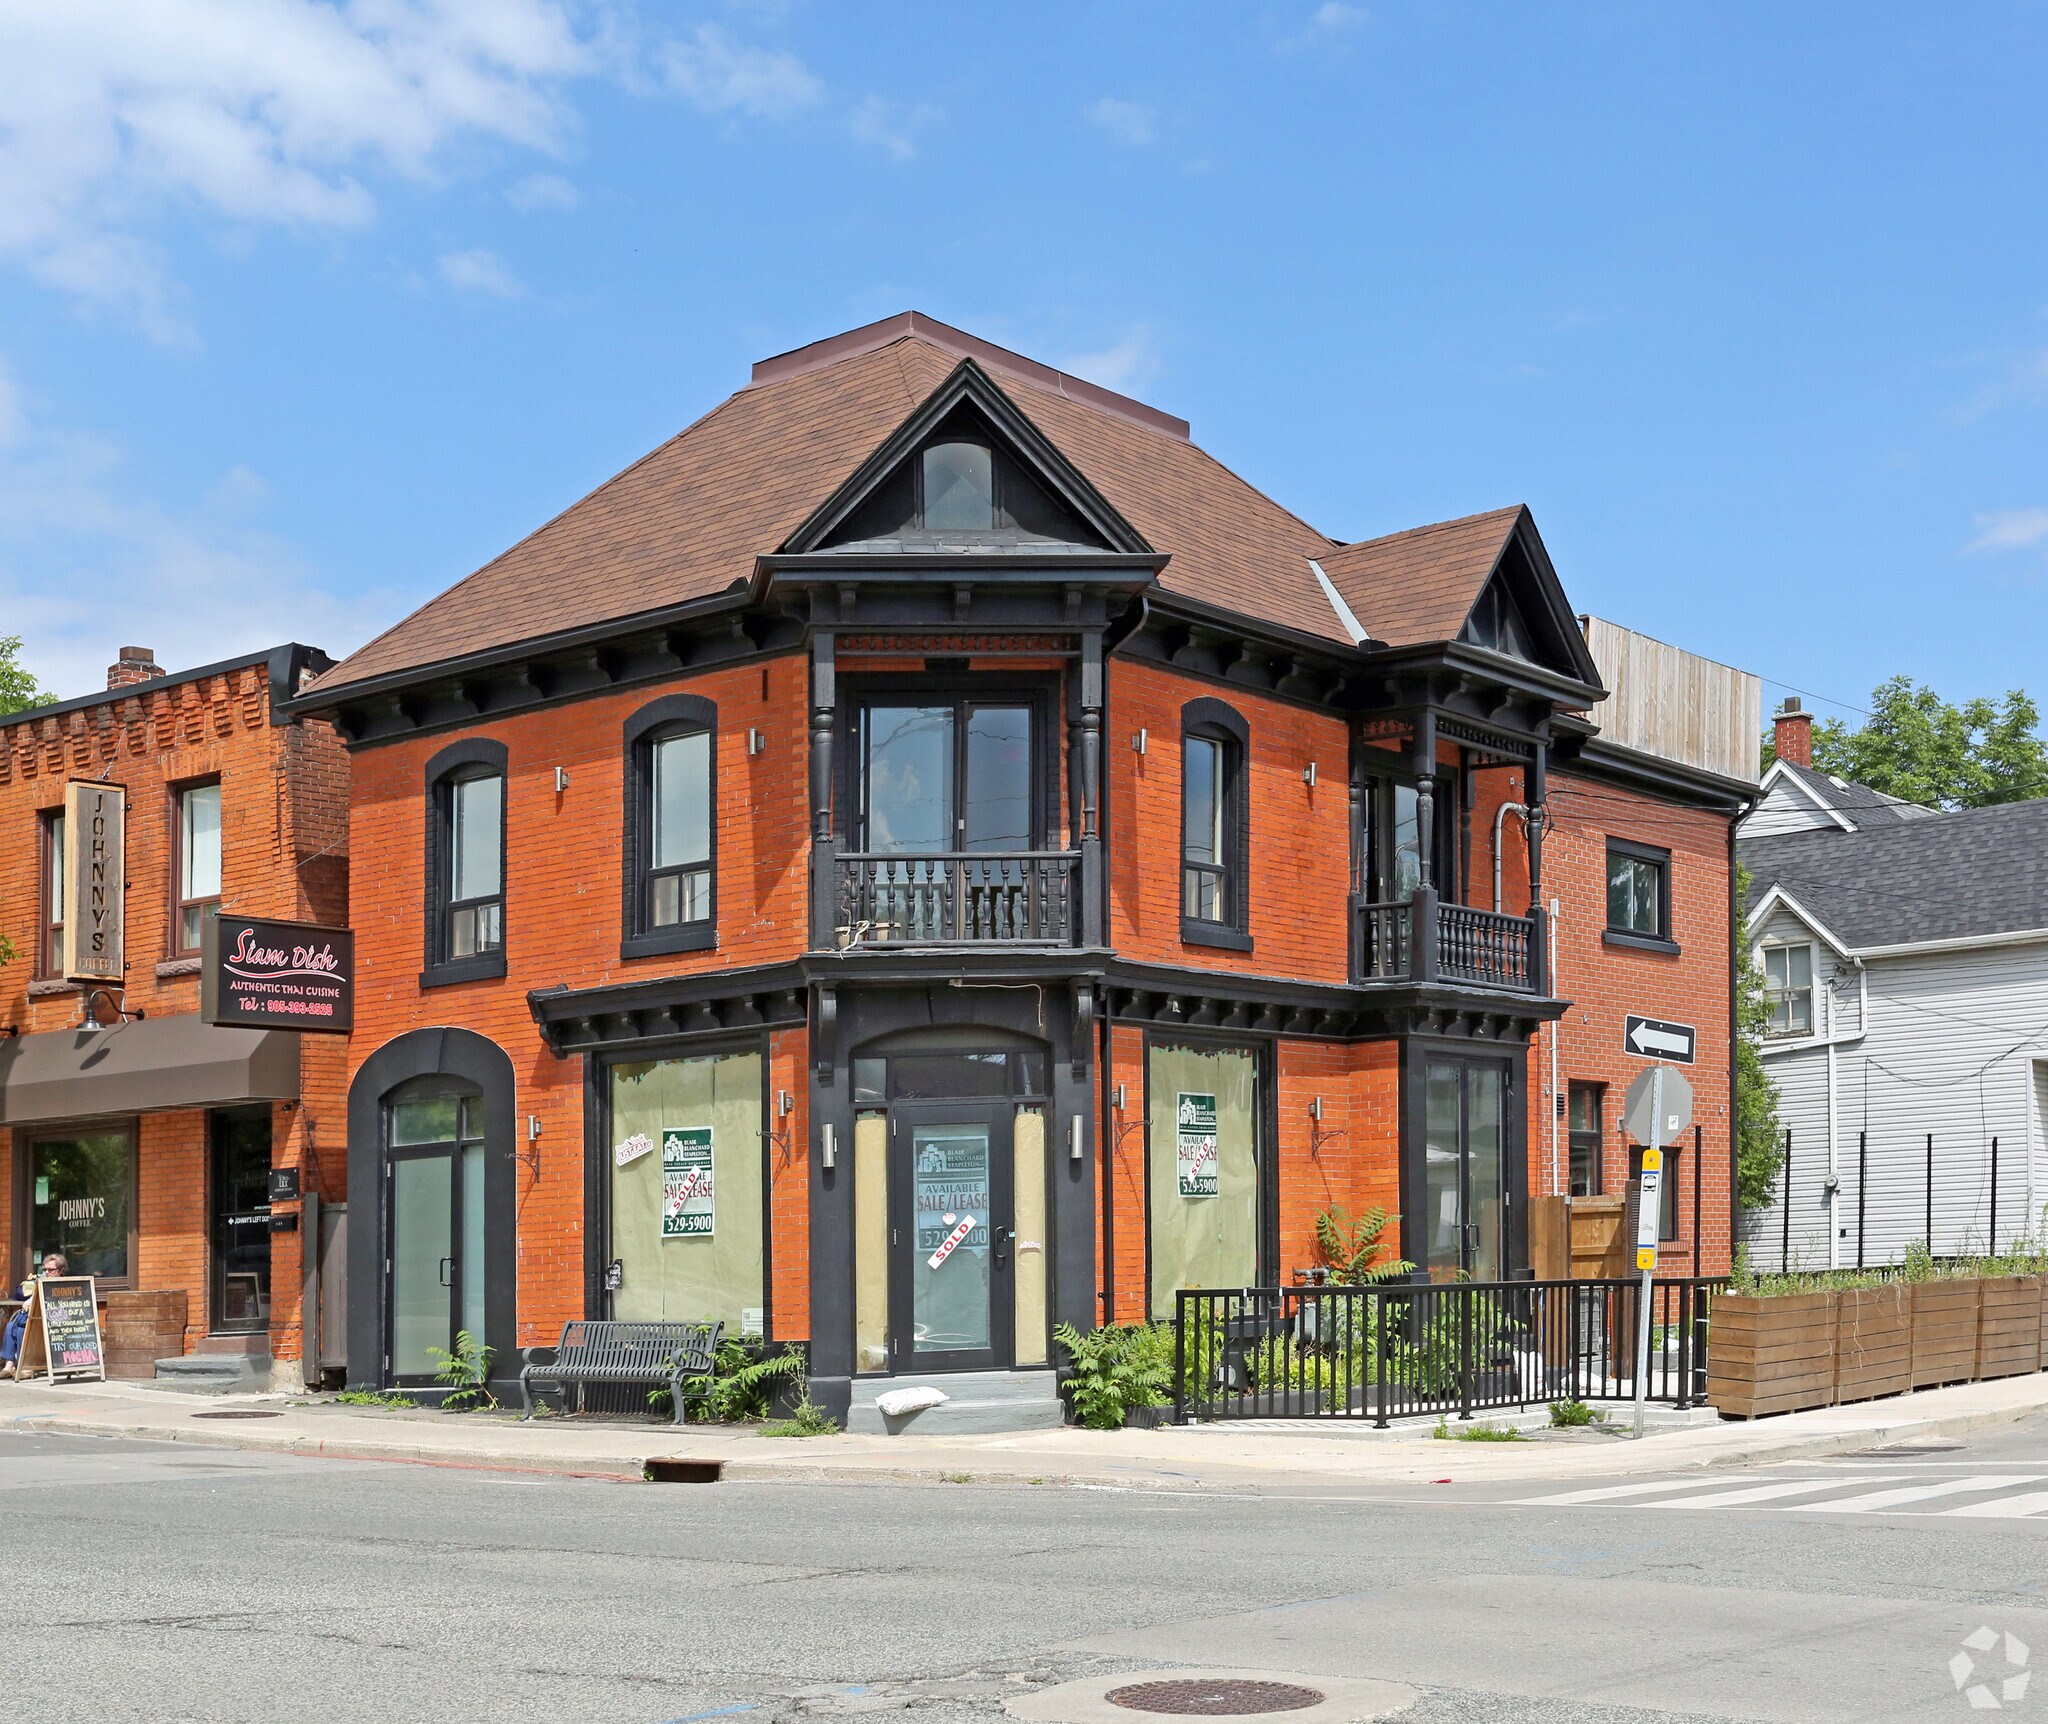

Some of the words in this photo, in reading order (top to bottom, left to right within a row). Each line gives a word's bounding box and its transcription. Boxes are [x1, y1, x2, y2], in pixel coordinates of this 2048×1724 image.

[92, 793, 110, 952] JOHNNY'S
[229, 928, 289, 967] Siam
[292, 944, 339, 971] Dish
[230, 980, 280, 994] AUTHENTIC
[281, 984, 304, 996] THAI
[306, 986, 340, 998] CUISINE
[239, 997, 259, 1011] Tel
[267, 999, 333, 1017] 905-393-2525
[1191, 1143, 1208, 1175] SOLD
[673, 1173, 697, 1210] SOLD
[926, 1183, 980, 1193] AVAILABLE
[1182, 1178, 1217, 1193] 529-5900
[58, 1197, 105, 1221] JOHNNY'S
[918, 1192, 987, 1212] SALE/LEASE
[69, 1219, 92, 1228] COFFEE
[234, 1216, 252, 1224] JOHNNY'S
[252, 1215, 261, 1223] LEFT
[667, 1215, 712, 1232] 529-5900
[935, 1223, 969, 1261] SOLD
[51, 1286, 83, 1298] JOHNNY'S
[79, 1308, 84, 1316] A
[51, 1342, 66, 1351] TRY
[69, 1342, 82, 1351] OUR
[83, 1341, 97, 1351] ICED
[62, 1349, 99, 1364] MOCHA
